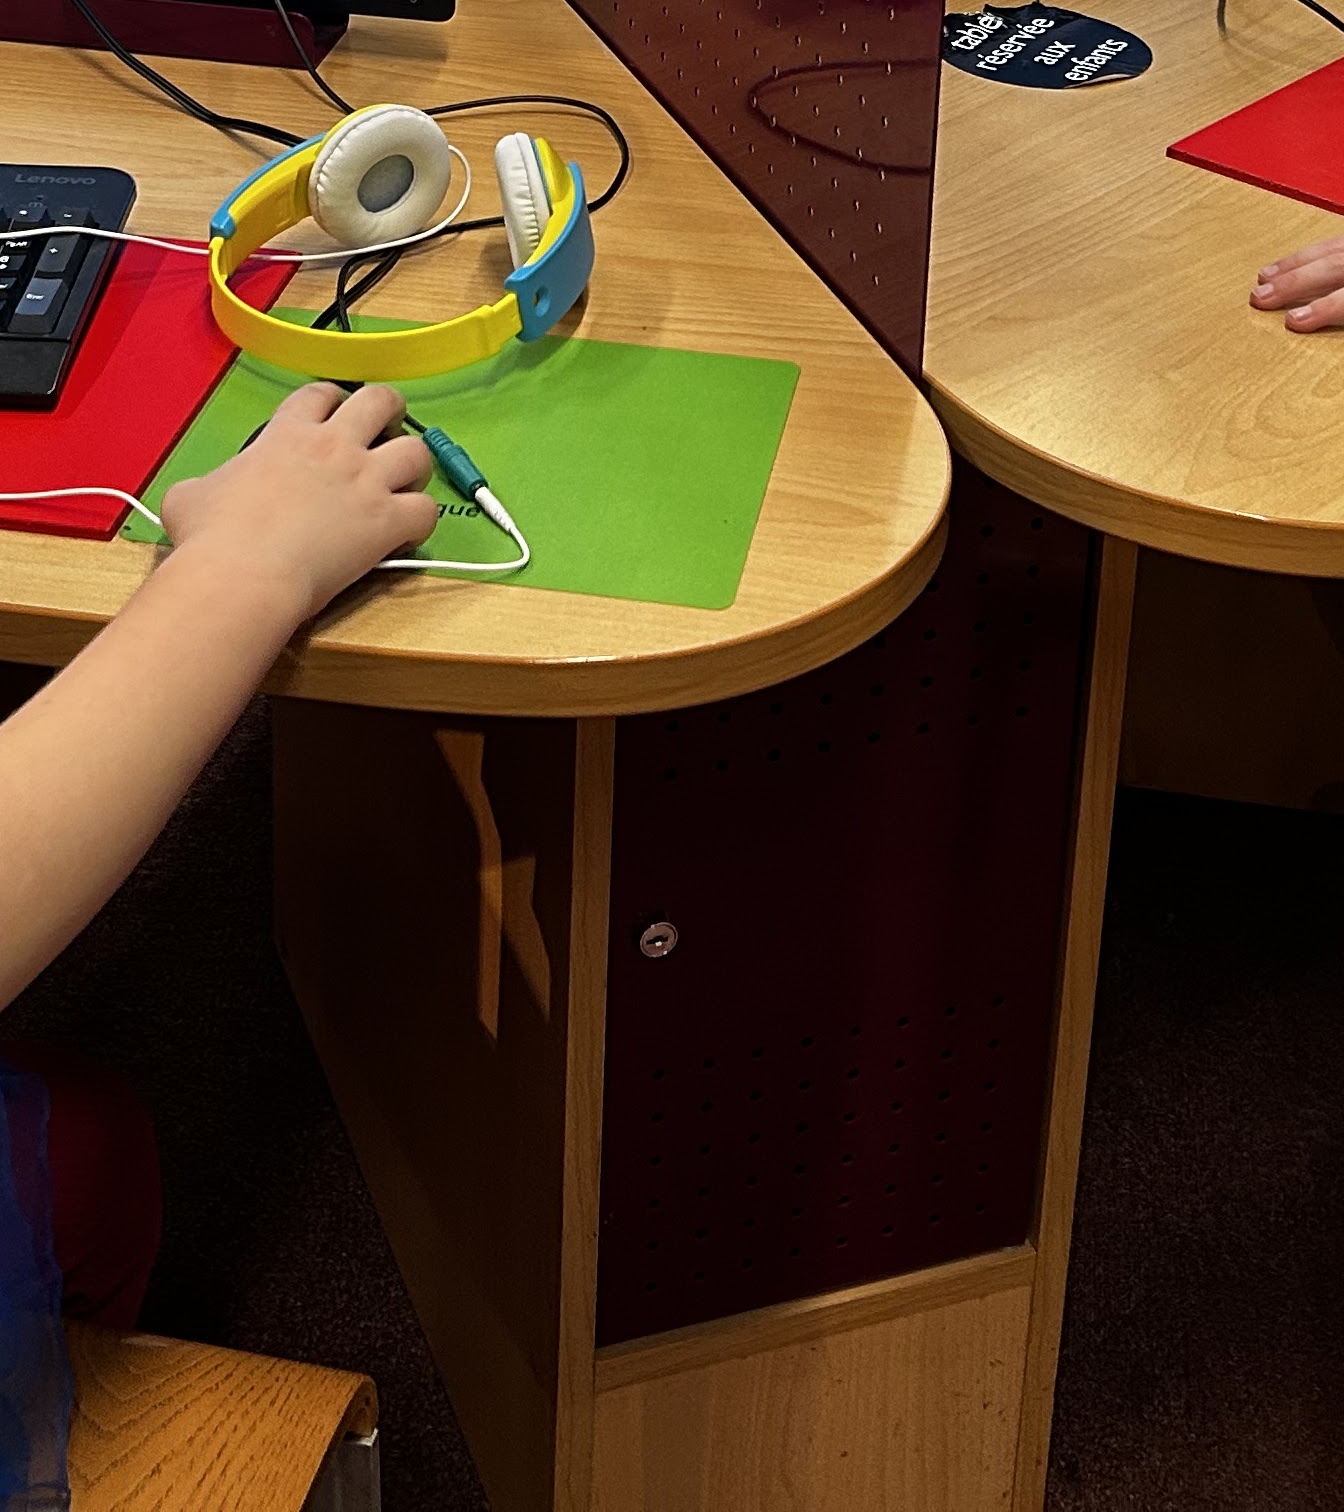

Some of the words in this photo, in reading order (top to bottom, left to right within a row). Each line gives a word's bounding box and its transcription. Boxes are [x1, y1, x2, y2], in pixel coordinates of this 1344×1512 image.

[976, 18, 1055, 70] réservée
[1033, 40, 1076, 65] aux
[1064, 37, 1129, 82] enfants
[14, 172, 96, 186] Lenovo
